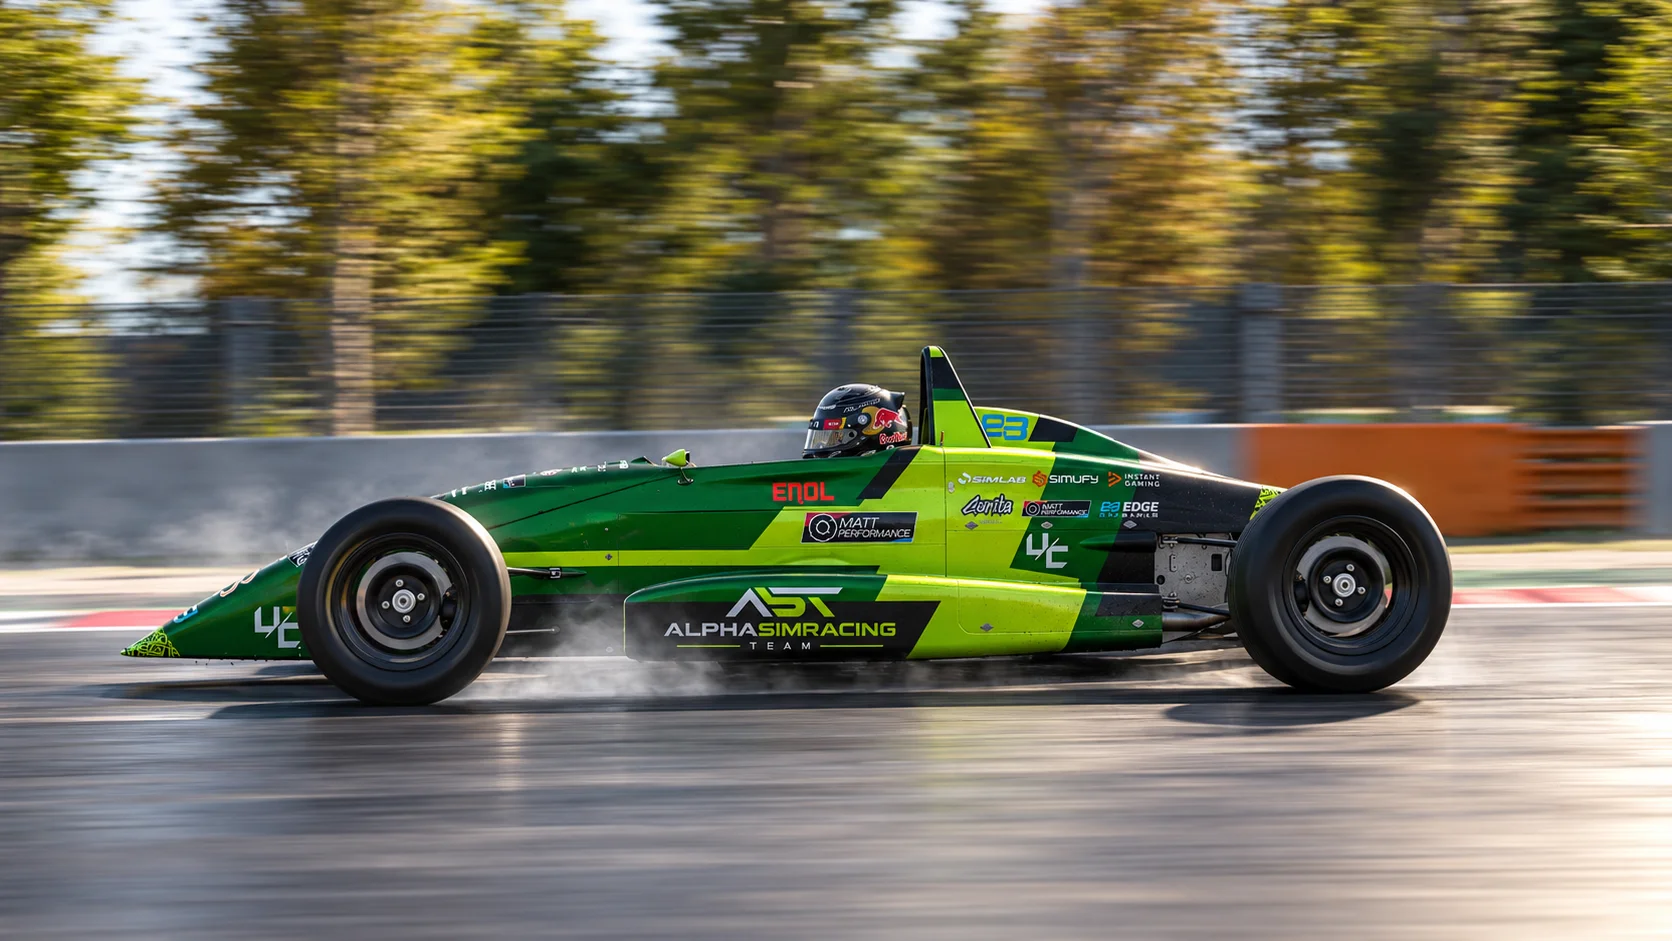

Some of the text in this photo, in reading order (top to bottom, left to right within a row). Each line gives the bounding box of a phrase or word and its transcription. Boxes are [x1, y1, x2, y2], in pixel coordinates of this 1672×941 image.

[971, 476, 1026, 484] SIMLAB
[1049, 474, 1099, 484] SIMUFY
[1122, 501, 1160, 512] EDGE
[839, 517, 879, 528] MATT
[838, 529, 911, 538] PERFORMANCE
[750, 642, 811, 650] TEAM
